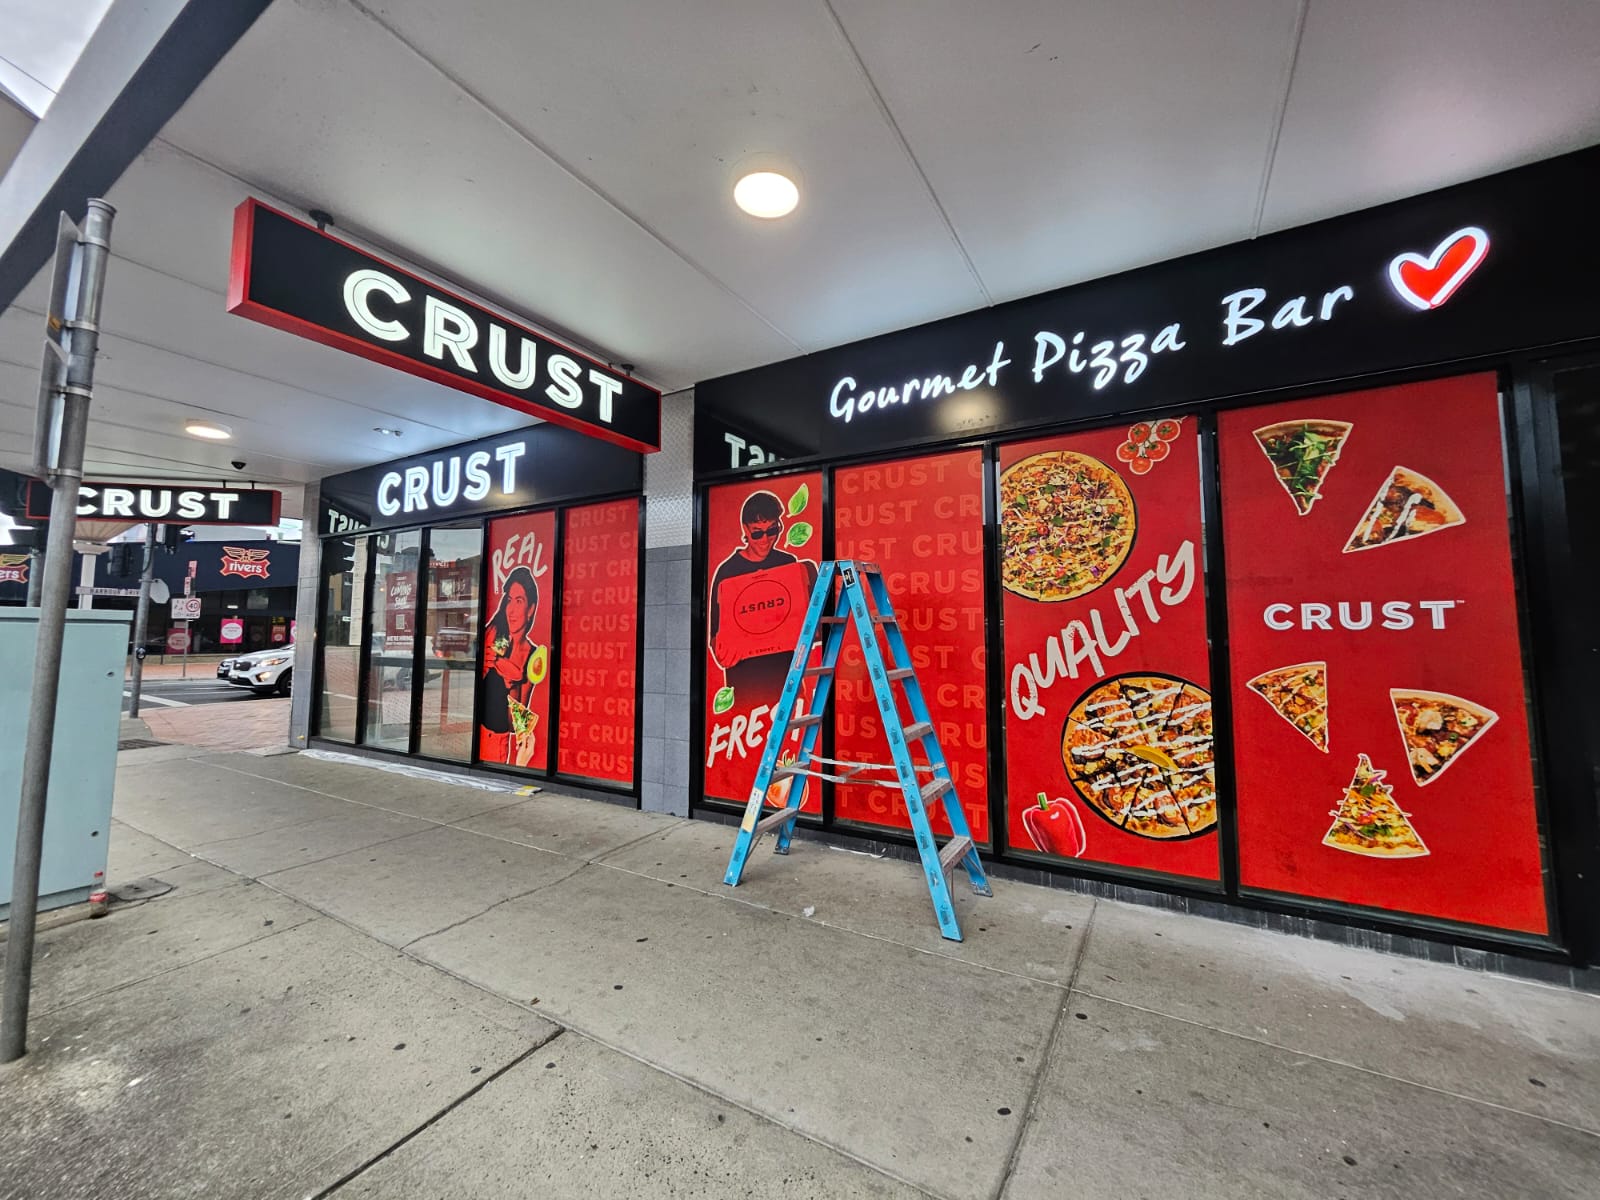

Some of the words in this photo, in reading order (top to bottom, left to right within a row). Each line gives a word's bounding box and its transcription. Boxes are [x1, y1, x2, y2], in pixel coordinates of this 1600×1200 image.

[343, 268, 623, 423] CRUST
[829, 340, 1012, 423] Gourmet
[1031, 322, 1186, 392] Pizza
[1221, 285, 1354, 346] Bar
[377, 441, 526, 516] CRUST
[841, 460, 950, 494] CRUST
[76, 486, 238, 520] CRUST
[836, 499, 918, 528] RUST
[933, 493, 979, 519] CR
[569, 505, 630, 528] CRUST
[619, 529, 638, 553] C
[229, 562, 262, 574] rivers
[492, 531, 548, 595] REAL
[591, 584, 637, 605] CRU
[887, 569, 980, 596] CRUS
[188, 601, 199, 610] 40
[739, 597, 785, 615] CRUST
[1263, 600, 1455, 630] CRUST
[579, 613, 637, 633] CRUS
[871, 608, 982, 632] RUST
[1011, 539, 1195, 721] QUALITY
[565, 641, 628, 660] CRUST
[560, 668, 608, 688] RUST
[616, 669, 635, 688] C
[561, 694, 596, 714] UST
[560, 721, 582, 740] ST
[588, 724, 635, 745] CRU
[576, 750, 634, 775] CRUS
